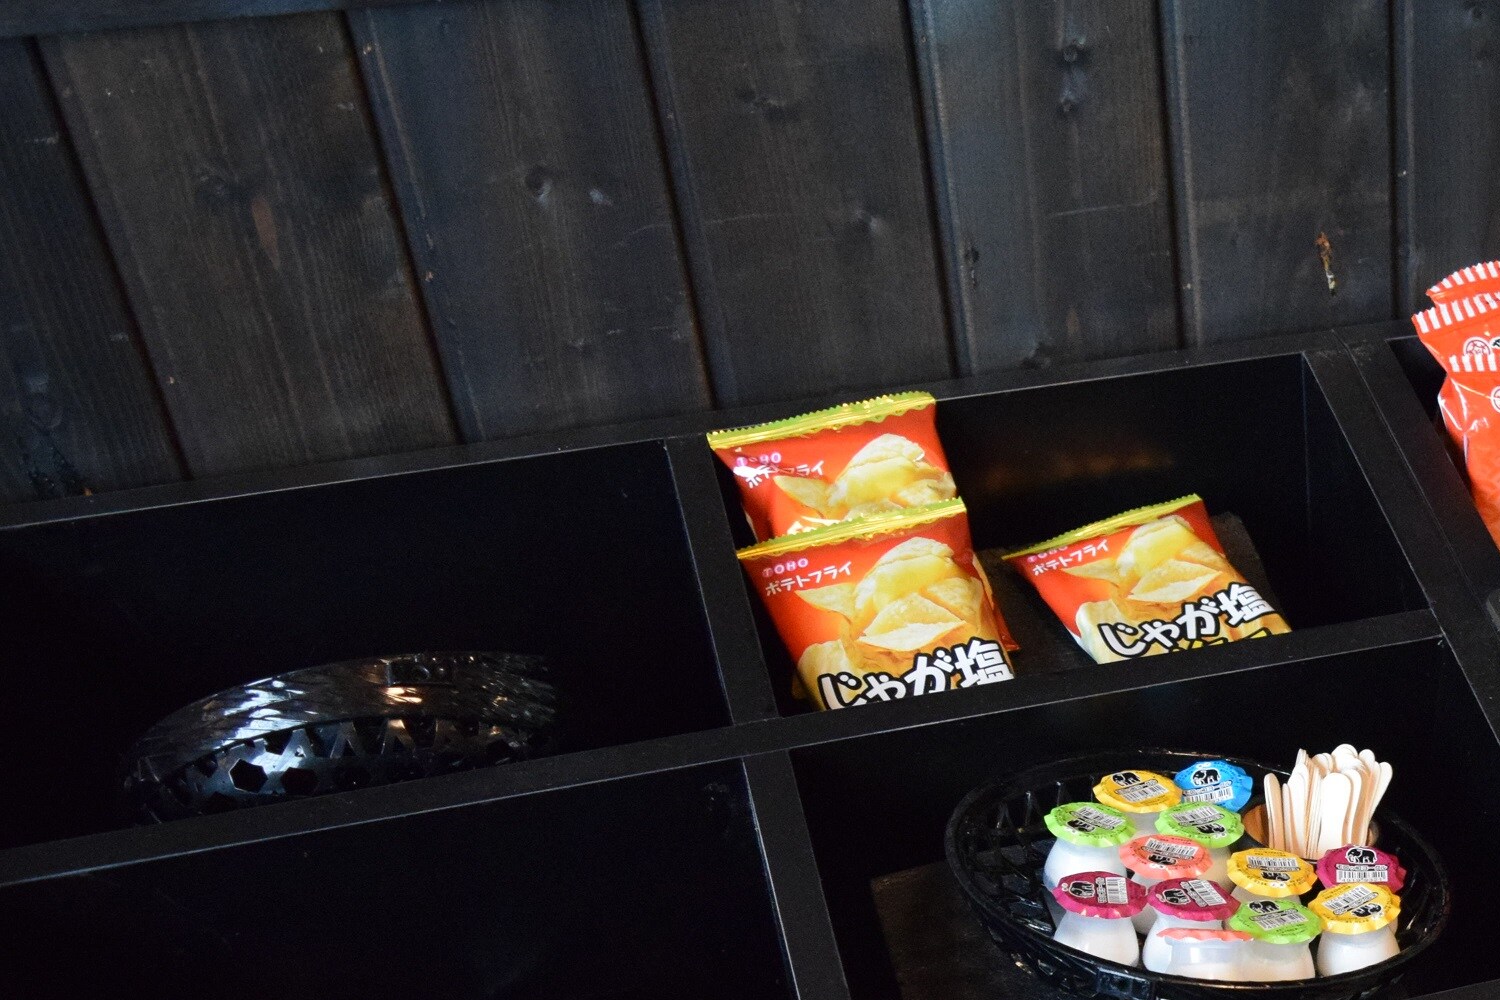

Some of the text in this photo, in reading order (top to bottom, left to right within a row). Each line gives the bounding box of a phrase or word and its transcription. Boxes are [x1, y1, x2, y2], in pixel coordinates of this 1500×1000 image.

[762, 557, 809, 577] TOHO
[1033, 539, 1110, 576] ポテトフライ
[765, 561, 852, 596] ポテトフライ
[1099, 582, 1276, 658] じゃが塩
